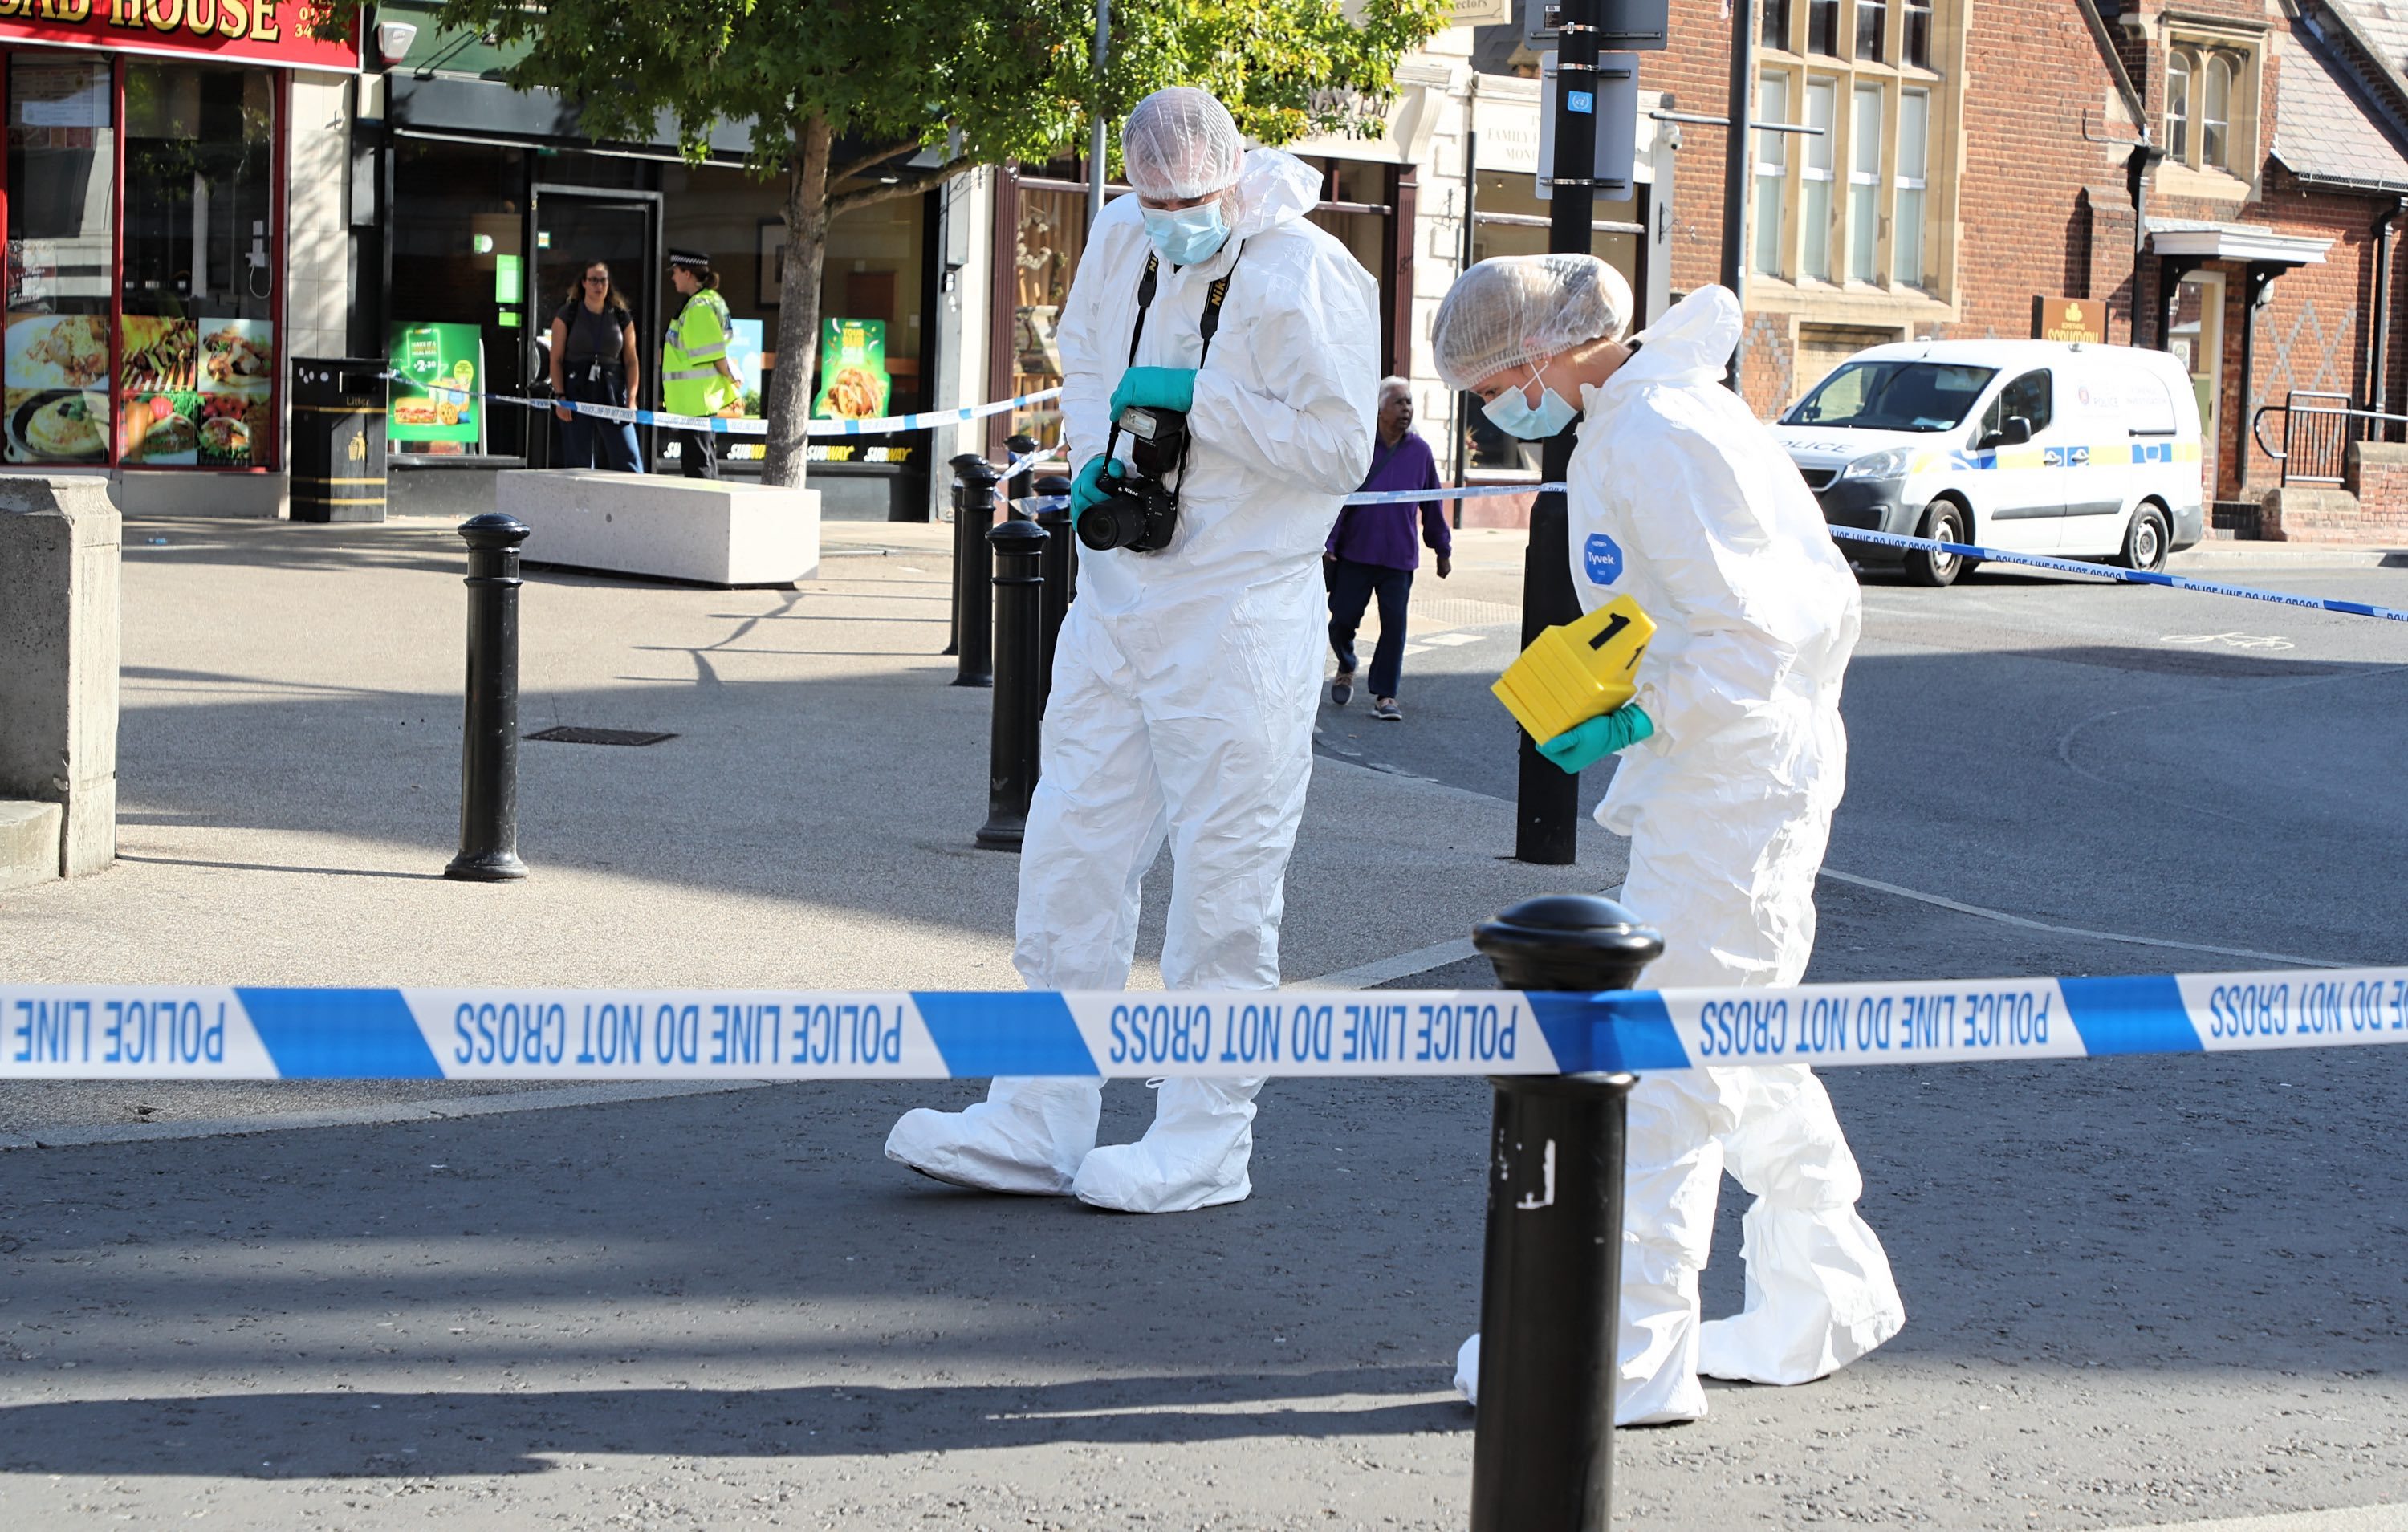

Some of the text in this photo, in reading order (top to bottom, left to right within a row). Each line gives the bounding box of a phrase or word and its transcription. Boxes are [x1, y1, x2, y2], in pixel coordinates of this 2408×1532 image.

[1487, 128, 1527, 144] FAMILY
[346, 396, 370, 407] Litter
[807, 445, 855, 461] SUBWAY
[864, 446, 913, 462] SUBWAY
[1778, 440, 1855, 454] OLICE
[1124, 486, 1139, 497] Nikon
[1588, 551, 1615, 566] Tyvek
[1588, 612, 1631, 651] 1
[1625, 644, 1645, 670] 1
[2209, 983, 2290, 1039] CROSS
[2296, 981, 2346, 1034] NOT
[2349, 980, 2386, 1033] DO
[14, 999, 226, 1065] POLICE LINE
[454, 1002, 903, 1066] POLICE LINE DO NOT CROSS
[1109, 1003, 1519, 1065] POLICE LINE DO NOT CROSS
[1699, 990, 2052, 1057] POLICE LINE DO NOT CROSS
